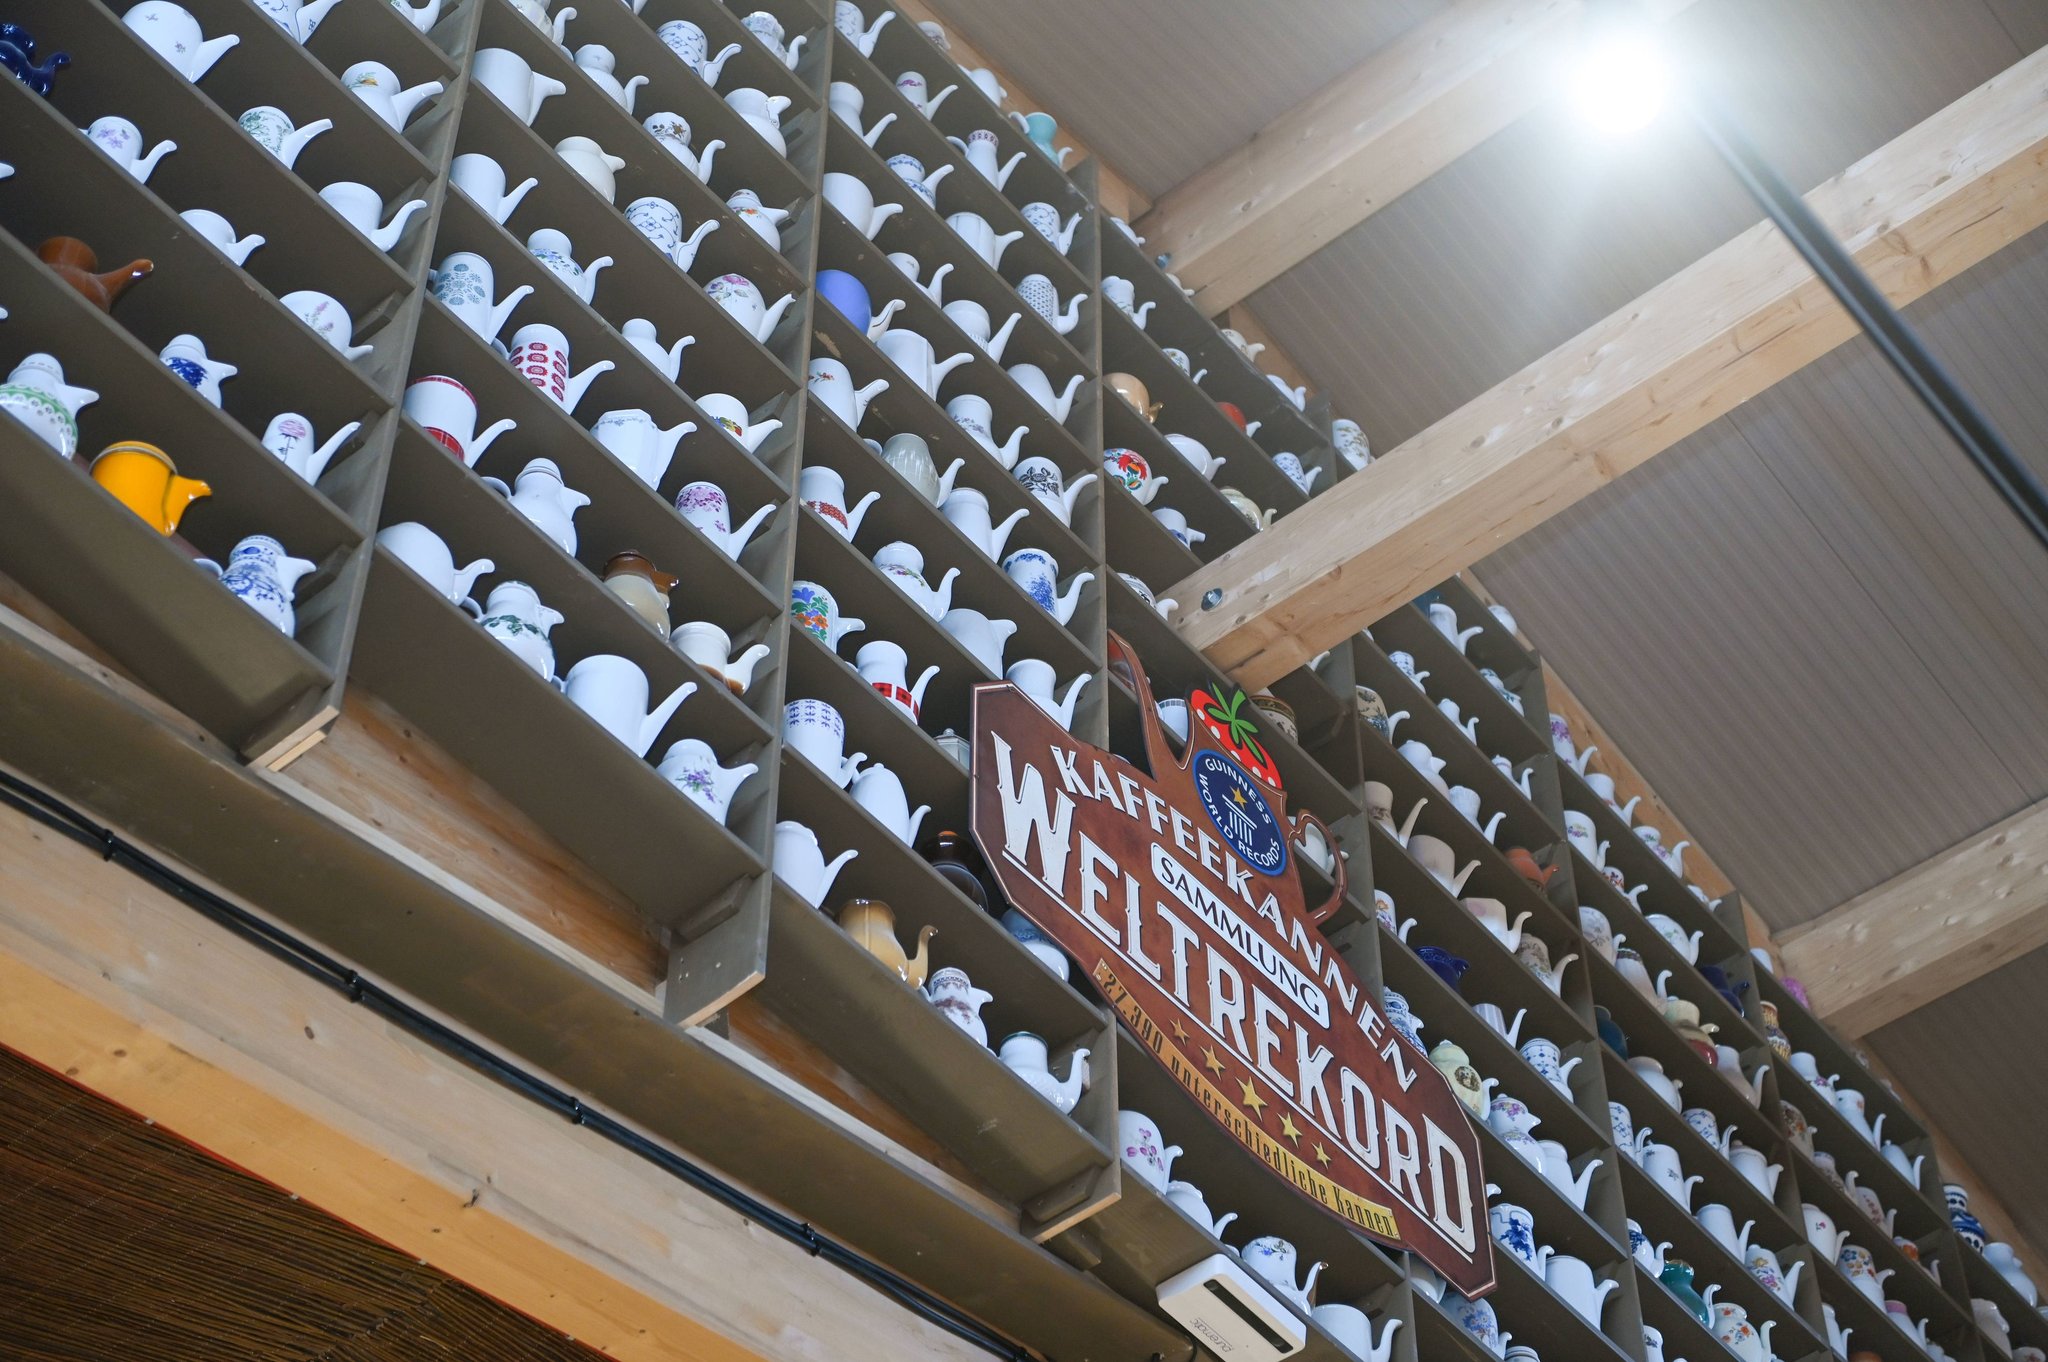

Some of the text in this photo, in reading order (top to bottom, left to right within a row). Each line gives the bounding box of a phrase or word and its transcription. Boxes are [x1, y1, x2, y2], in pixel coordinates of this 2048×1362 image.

[1199, 773, 1280, 867] WORLD RECORDS
[1205, 758, 1271, 824] GUINNESS
[991, 731, 1475, 1253] WELTREKORD
[1050, 745, 1417, 1092] KAFFEEKANNEN
[1161, 857, 1319, 1014] SAMMLUNG
[1103, 973, 1394, 1237] 27.390 unterschiedliche Kannen
